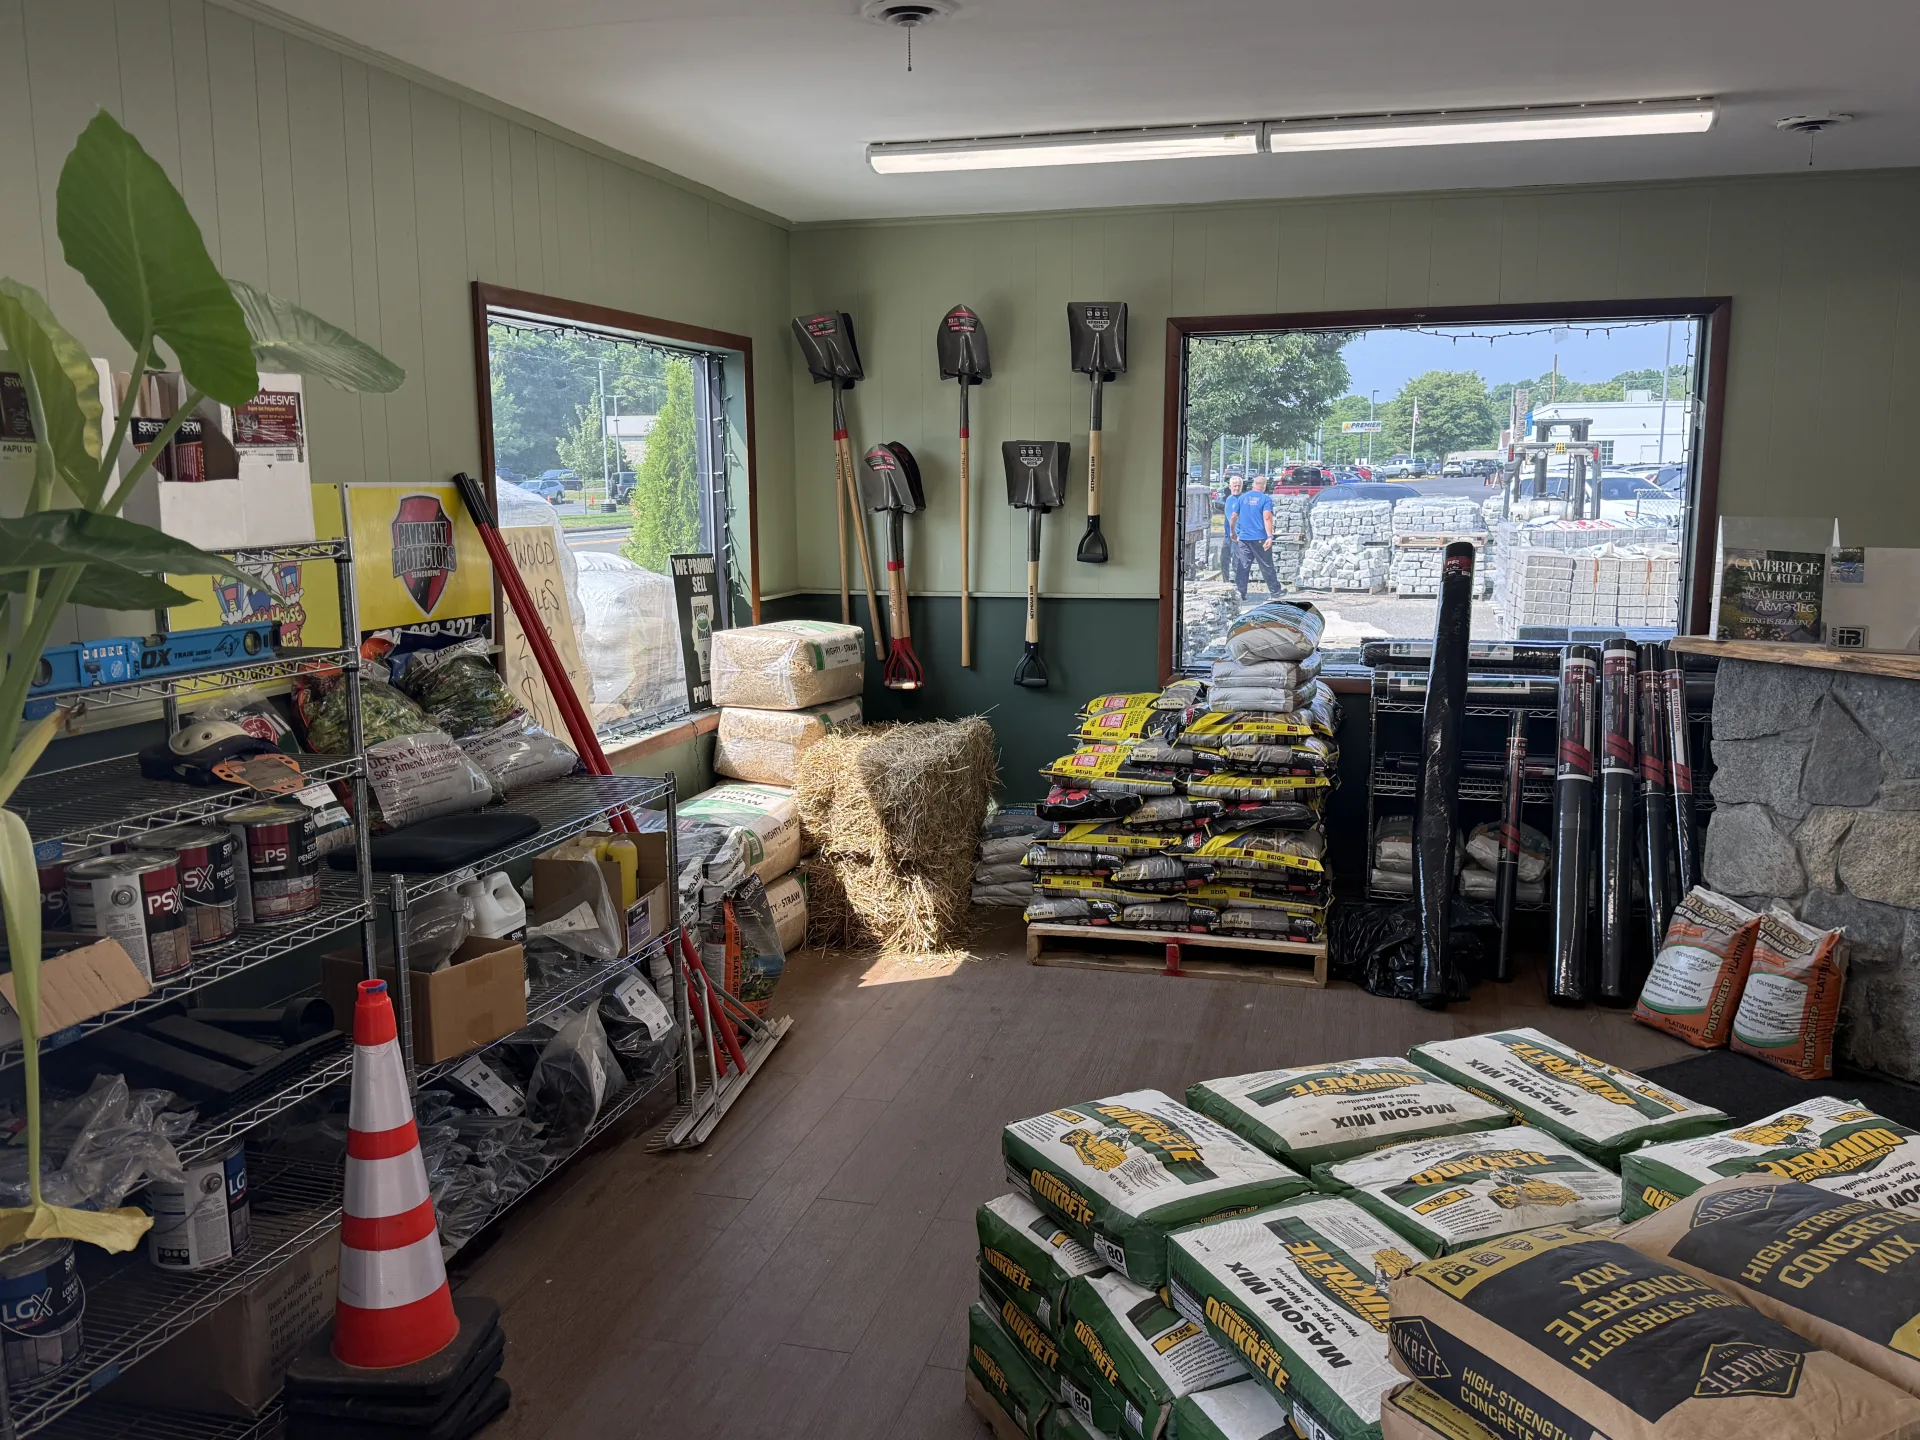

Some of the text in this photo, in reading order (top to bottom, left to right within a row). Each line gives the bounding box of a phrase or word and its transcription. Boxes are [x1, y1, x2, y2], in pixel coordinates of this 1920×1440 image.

[1350, 421, 1381, 429] PREMIER
[24, 445, 33, 455] 10
[397, 522, 448, 546] PAVEMENT
[393, 545, 457, 577] PROTECTORS
[674, 558, 688, 576] WE
[1735, 557, 1820, 576] CAMBRIDGE
[692, 575, 708, 593] SELL
[1745, 571, 1809, 585] ARMORTEC
[1754, 587, 1816, 601] CAMBRIDGE
[1740, 616, 1765, 624] SEEING
[142, 648, 172, 669] OX
[174, 651, 195, 660] TRADE
[762, 814, 799, 844] MIGHTY STRAW
[1388, 815, 1408, 823] HP
[1267, 853, 1285, 862] BEIGE
[184, 863, 214, 893] SX
[147, 883, 183, 915] PSX
[782, 891, 801, 909] STRAW
[1687, 909, 1703, 923] DAMN
[1763, 934, 1782, 951] DAMN
[733, 955, 741, 980] SLATE
[1669, 965, 1689, 976] Strength
[1701, 958, 1718, 968] SAND
[1659, 975, 1698, 994] Lasting Durability
[1662, 983, 1679, 994] Limited
[1678, 988, 1703, 1003] Warranty
[1672, 974, 1702, 987] Guaranteed
[1703, 926, 1751, 1039] POLYSWEEP PLATINUM
[1756, 979, 1802, 996] POLYMERIC SAND
[1752, 995, 1774, 1007] Strength
[1757, 1004, 1789, 1018] Guaranteed
[1801, 950, 1832, 1069] POLYSWEEP PLATINUM
[1664, 1017, 1700, 1035] PLATINUM
[1749, 1016, 1794, 1033] Limited Warranty
[1759, 1012, 1786, 1024] Durability
[1758, 1050, 1797, 1066] PLATINUM
[1285, 1072, 1425, 1098] QUIKRETE
[1508, 1041, 1638, 1106] QUIKRETE
[1313, 1081, 1411, 1098] COMMERCIAL GRADE
[1465, 1058, 1578, 1117] MASON MIX
[1352, 1103, 1386, 1112] Mortar
[1398, 1099, 1420, 1108] Type
[1466, 1085, 1525, 1119] COMMERCIAL GRADE
[1330, 1103, 1458, 1130] MASON MIX
[1096, 1104, 1205, 1163] QUIKRETE
[1756, 1127, 1908, 1180] QUIKRETE
[1796, 1145, 1896, 1184] COMMERCIAL GRADE
[1409, 1150, 1556, 1187] QUIKRETE
[1897, 1172, 1920, 1186] Type
[228, 1167, 247, 1197] LG
[1041, 1169, 1089, 1207] COMMERCIAL GRADE
[1029, 1168, 1097, 1231] QUIKRETE
[1424, 1195, 1451, 1207] TYPE
[1697, 1186, 1773, 1223] SAKRETE
[1200, 1204, 1260, 1224] COMMERCIAL GRADE
[1106, 1243, 1124, 1265] 80
[1778, 1210, 1920, 1289] CONCRETE
[1856, 1234, 1920, 1274] MIX
[984, 1246, 1033, 1293] QUIKRETE
[1223, 1261, 1272, 1296] MIX
[1289, 1254, 1322, 1279] GRADE
[1440, 1263, 1478, 1286] 80
[1558, 1261, 1634, 1295] MIX
[1266, 1273, 1301, 1304] Mortar
[2, 1287, 54, 1323] LGX
[1543, 1274, 1714, 1346] CONCRETE
[1002, 1299, 1060, 1372] QUIKRETE
[1165, 1324, 1193, 1342] TYPE
[1220, 1301, 1284, 1363] COMMERCIAL GRADE
[1266, 1296, 1353, 1370] MASON
[1310, 1308, 1336, 1338] Type
[1409, 1327, 1423, 1339] SINCE
[1570, 1292, 1751, 1370] HIGH-STRENGTH
[1074, 1319, 1120, 1387] QUIKRETE
[1205, 1294, 1290, 1394] QUIKRETE
[1390, 1322, 1442, 1378] SAKRETE
[973, 1344, 1009, 1396] QUIKRETE
[1700, 1347, 1796, 1394] SAKRETE
[1074, 1391, 1090, 1412] 80
[1460, 1386, 1535, 1440] CONCRETE
[1462, 1366, 1575, 1440] HIGH-STRENGTH
